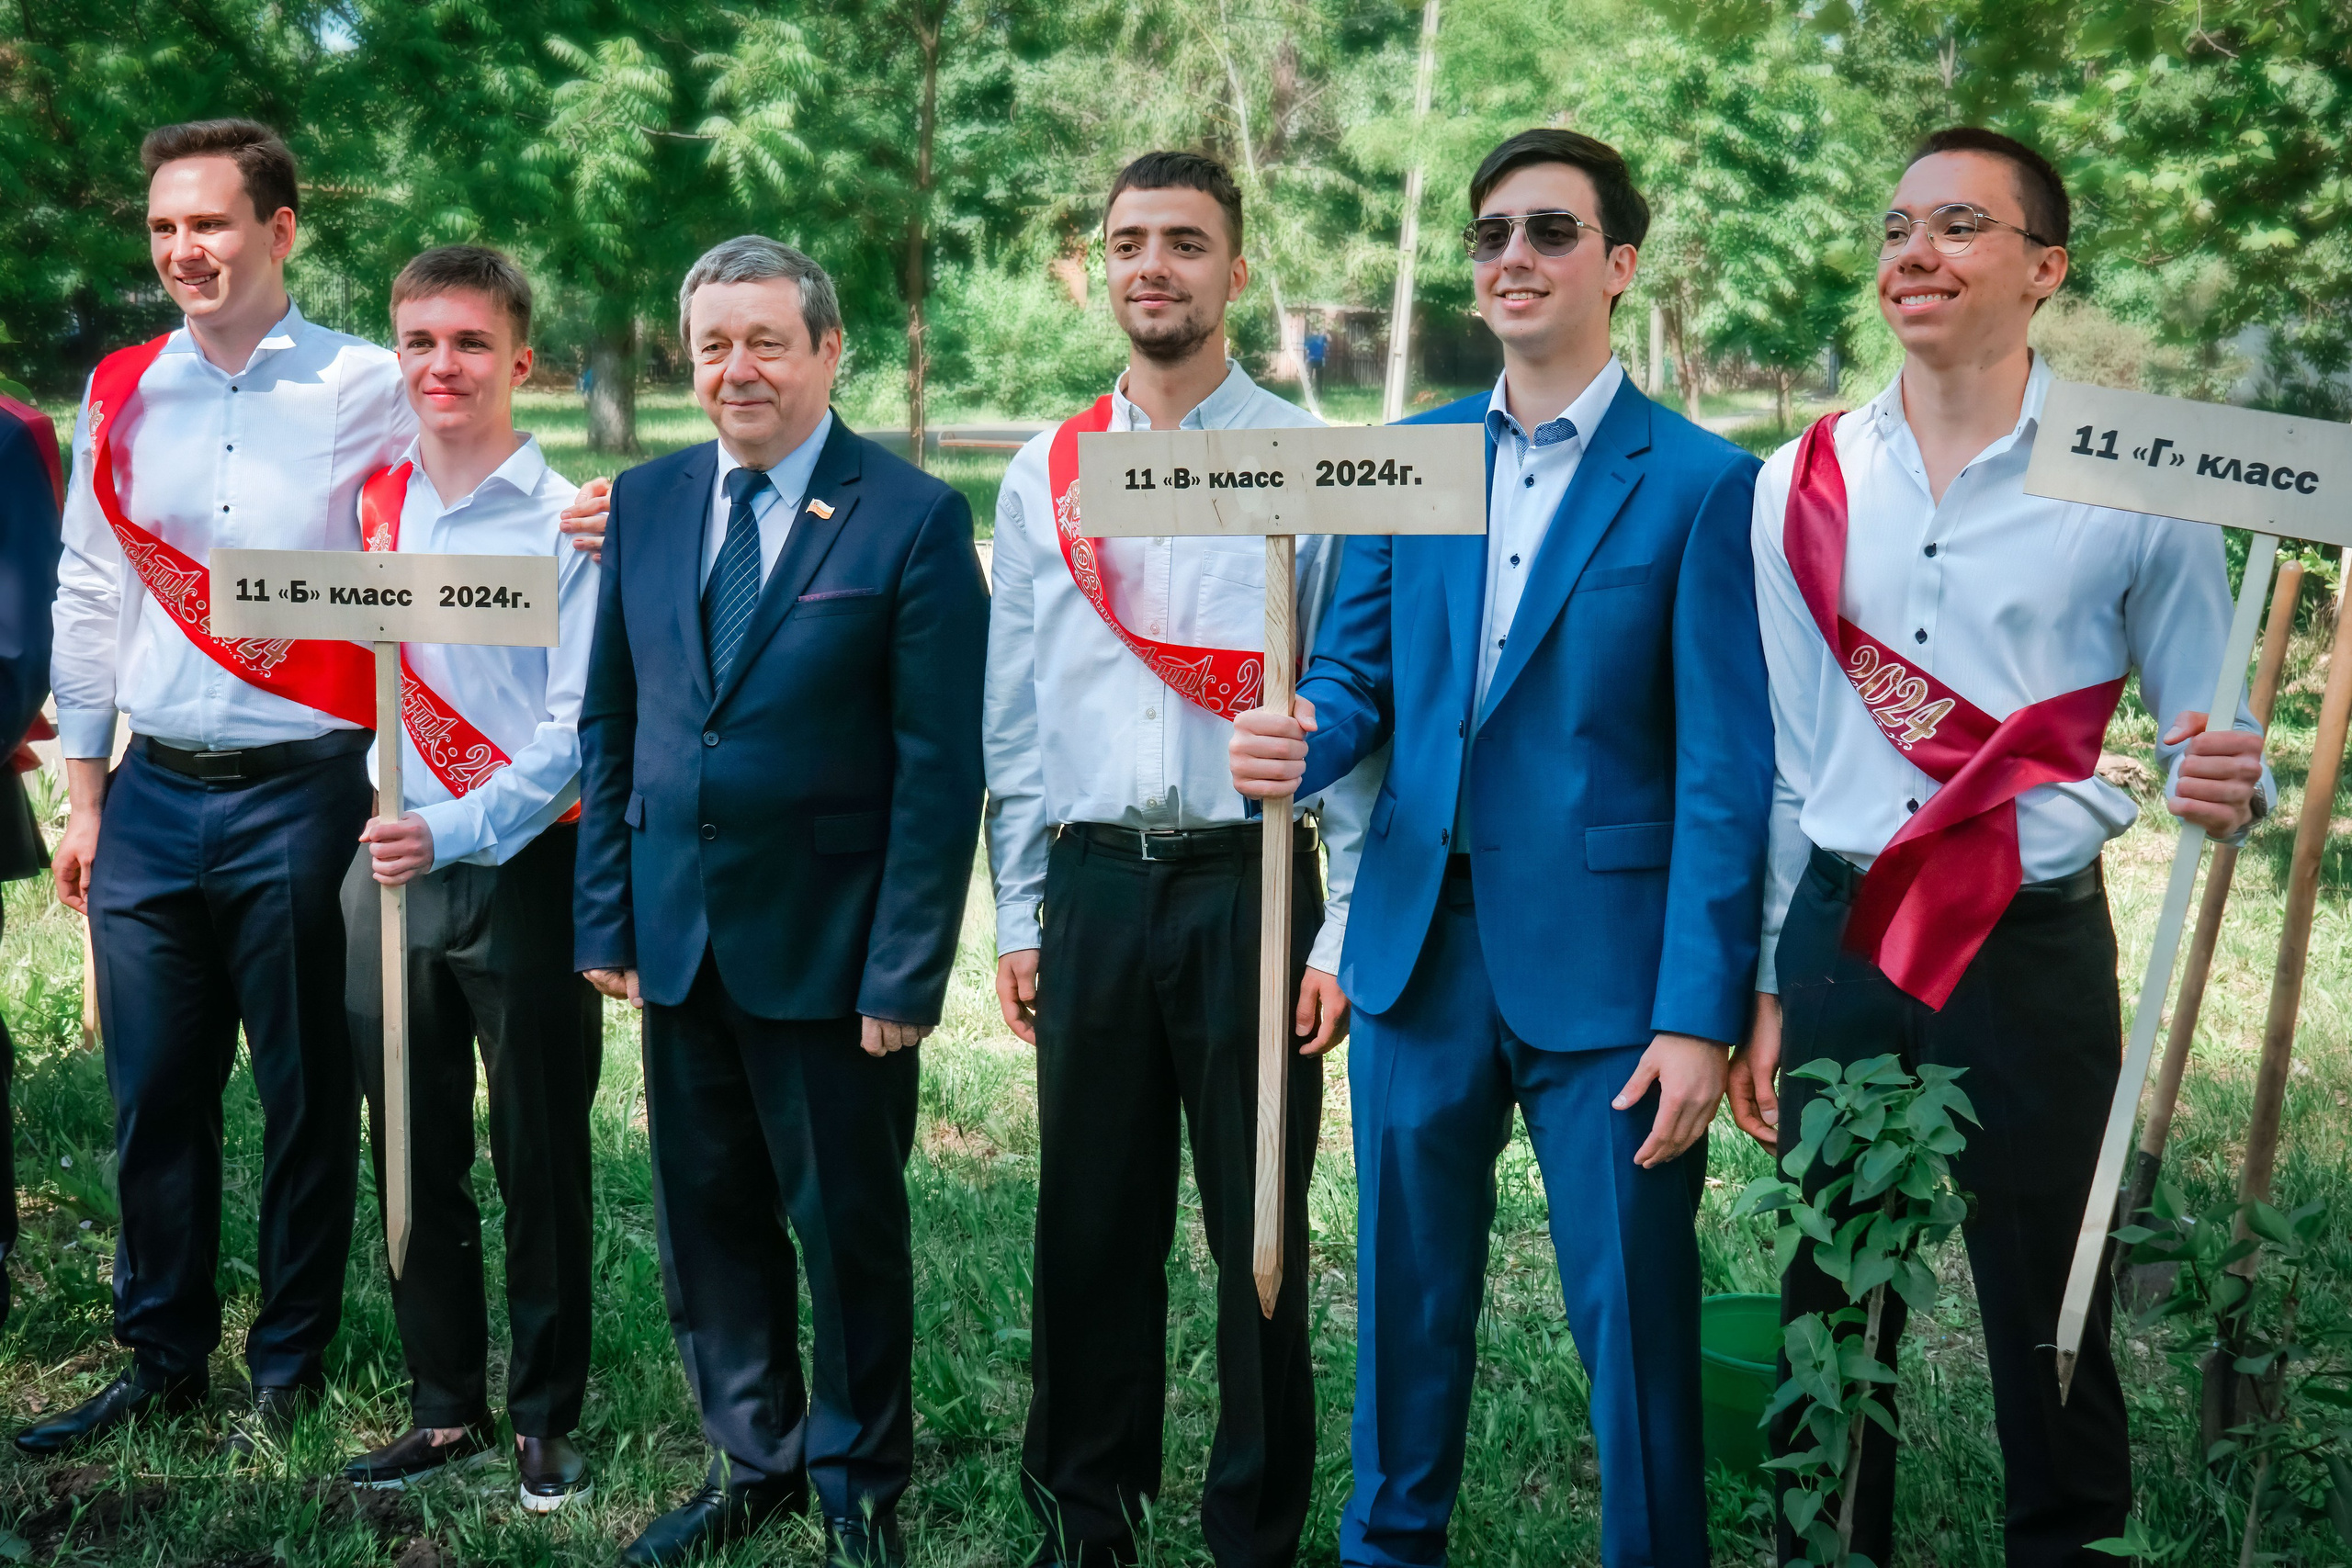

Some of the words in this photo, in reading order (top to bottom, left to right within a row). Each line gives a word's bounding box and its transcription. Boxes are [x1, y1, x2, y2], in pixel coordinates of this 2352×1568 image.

[1125, 468, 1157, 491] 11
[1163, 468, 1201, 490] «В»
[1208, 469, 1284, 489] класс
[1316, 458, 1422, 487] 2024г.
[2070, 424, 2120, 460] 11
[2132, 437, 2185, 468] «Г»
[2196, 453, 2320, 495] класс
[235, 578, 270, 603] 11
[277, 580, 321, 604] «Б»
[329, 586, 413, 607] класс
[439, 585, 531, 609] 2024г.
